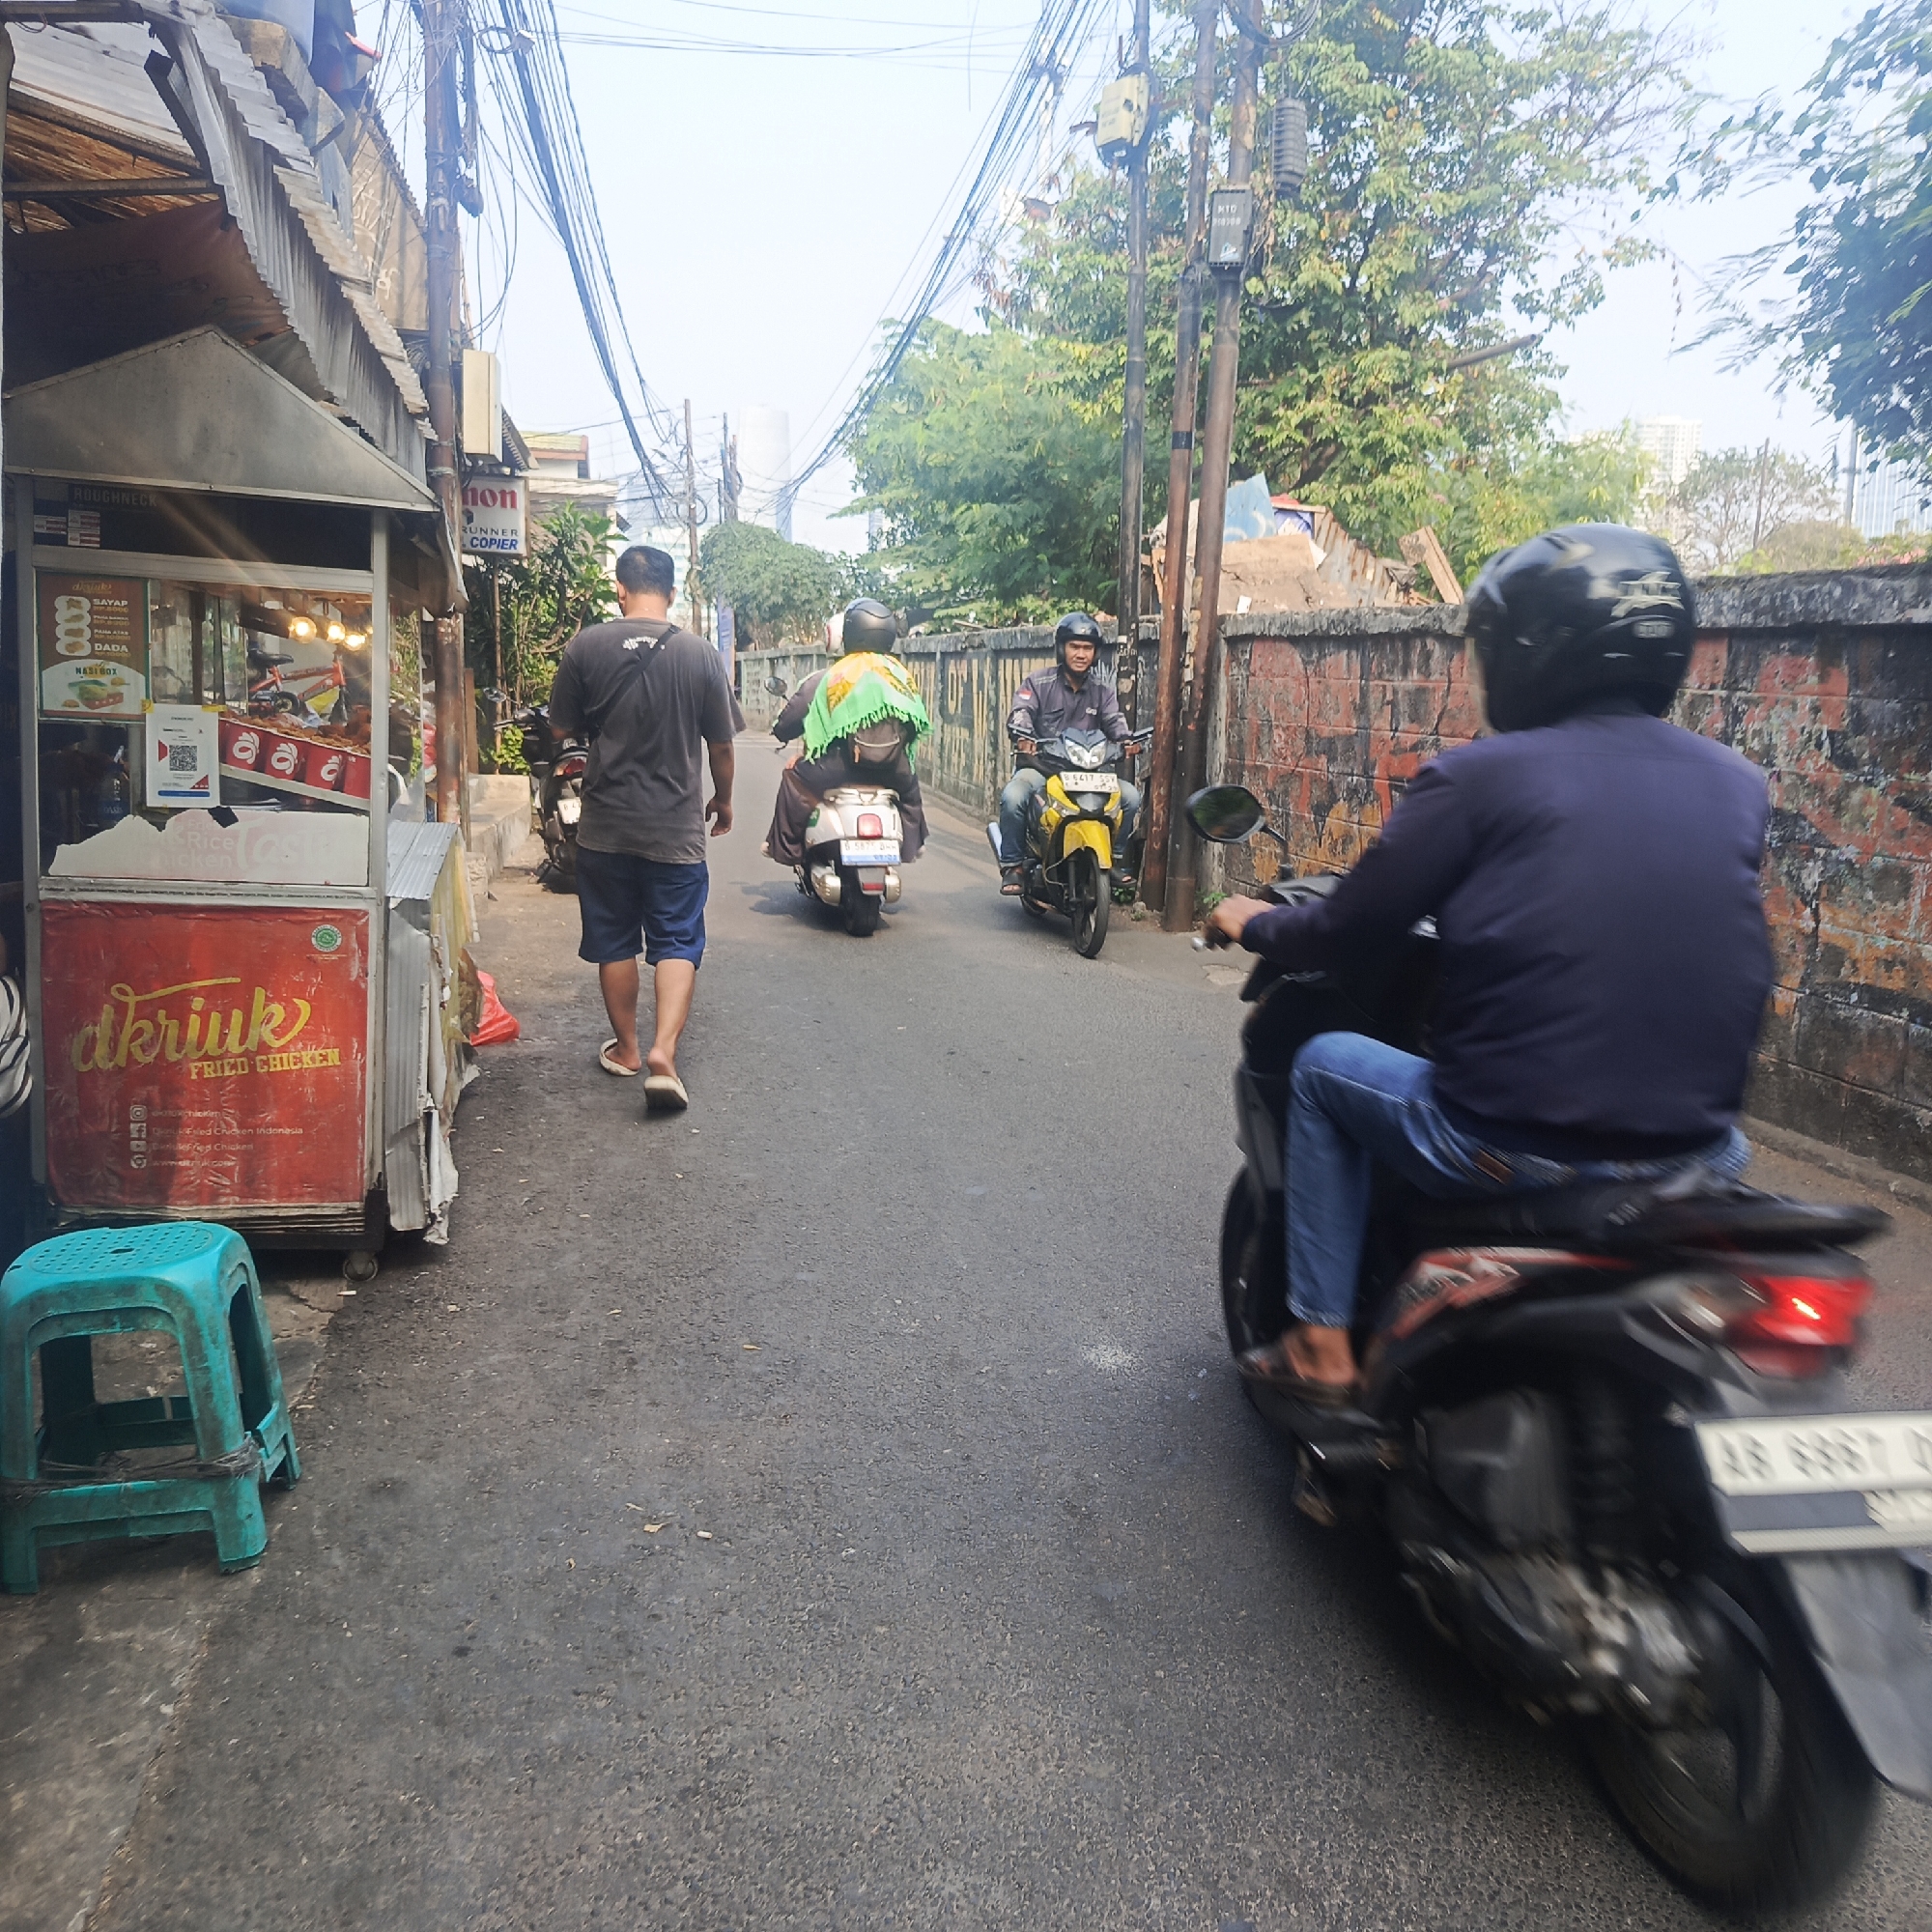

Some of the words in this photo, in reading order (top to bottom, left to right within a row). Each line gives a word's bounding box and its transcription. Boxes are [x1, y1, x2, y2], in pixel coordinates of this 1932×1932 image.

[73, 487, 158, 507] ROUGHNECK
[469, 536, 519, 550] COPIER
[95, 643, 128, 652] DADA
[75, 667, 98, 675] NASI
[99, 667, 117, 675] BOX
[186, 831, 234, 850] Rice
[71, 978, 311, 1072] dkriuk
[190, 1057, 249, 1080] FRIED
[257, 1048, 342, 1072] CHICKEN
[256, 1126, 303, 1135] Indonesia
